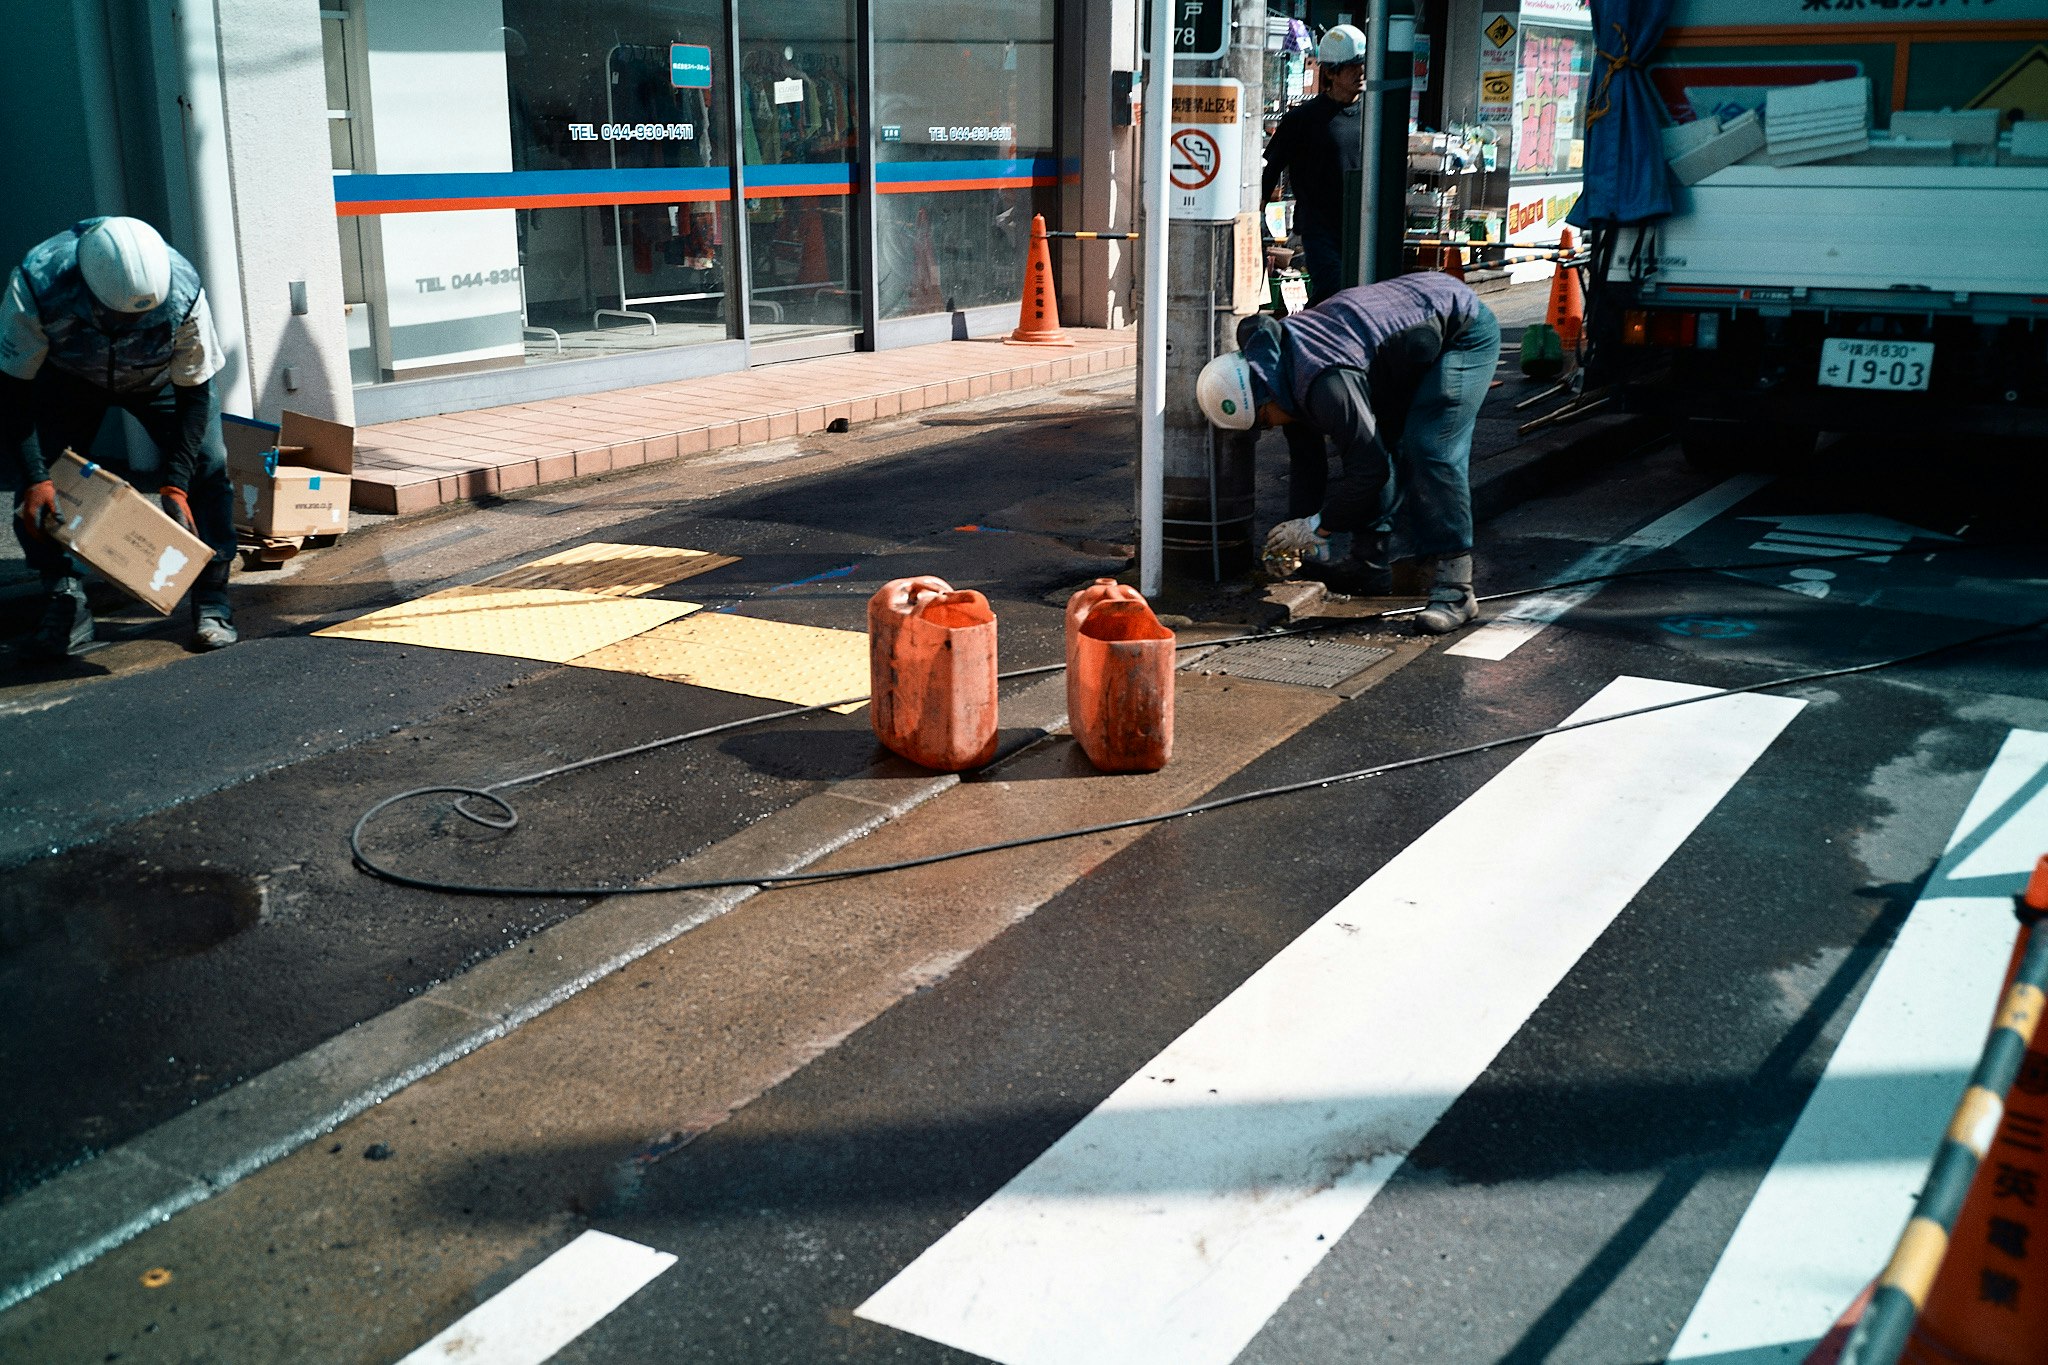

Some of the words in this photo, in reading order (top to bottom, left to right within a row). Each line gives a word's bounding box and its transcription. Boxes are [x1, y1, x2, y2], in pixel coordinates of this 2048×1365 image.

[568, 123, 599, 140] TEL
[601, 123, 694, 140] 044-930-1411
[928, 126, 949, 141] TEL
[1846, 359, 1924, 387] 19-03
